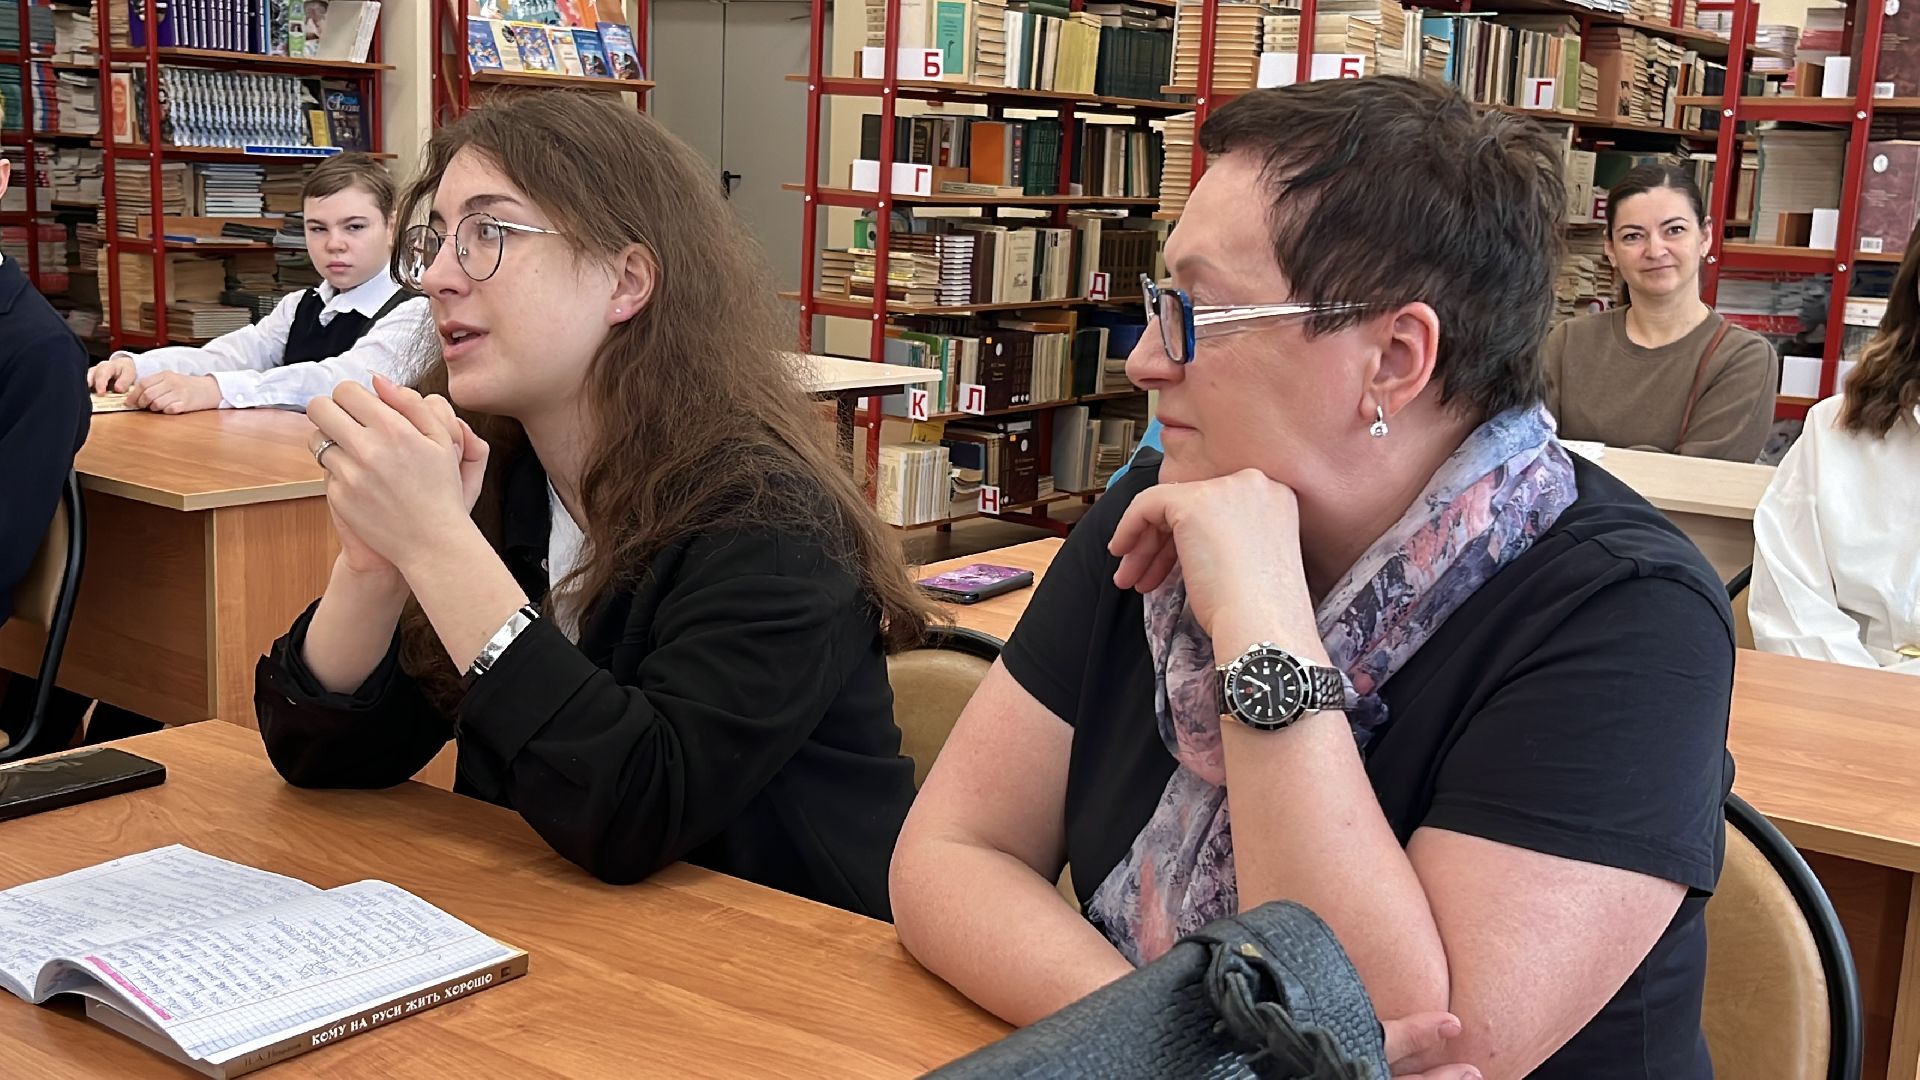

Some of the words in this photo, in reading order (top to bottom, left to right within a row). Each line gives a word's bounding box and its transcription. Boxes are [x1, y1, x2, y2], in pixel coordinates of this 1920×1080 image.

[924, 52, 941, 77] Б
[1340, 57, 1359, 80] Б
[1535, 81, 1552, 105] Г
[915, 167, 928, 192] Г
[1089, 272, 1106, 300] Д
[911, 392, 926, 418] К
[966, 387, 983, 412] Л
[981, 487, 998, 512] Н
[312, 1024, 346, 1046] КОМУ
[350, 1017, 368, 1032] НА
[371, 1005, 402, 1024] РУСИ
[405, 991, 441, 1012] ЖИТЬ
[444, 972, 493, 998] ХОРОШО
